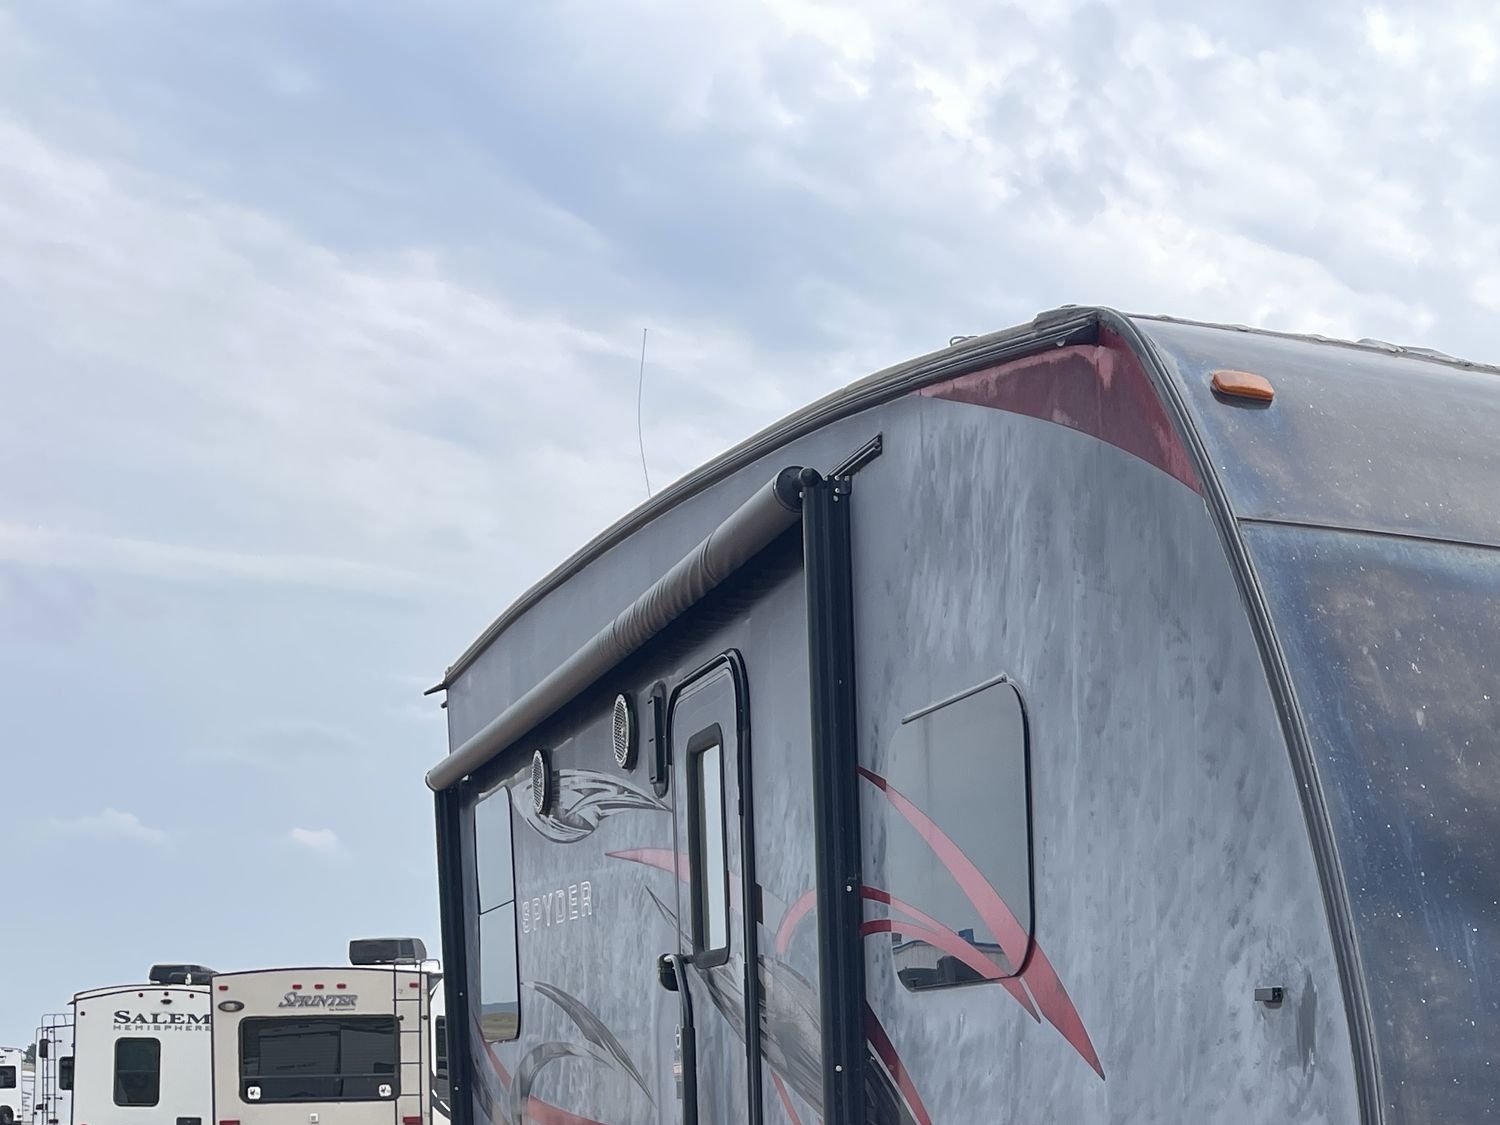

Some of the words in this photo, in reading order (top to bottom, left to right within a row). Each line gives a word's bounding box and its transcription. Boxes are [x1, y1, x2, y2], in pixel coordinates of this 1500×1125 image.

[522, 880, 592, 933] SPYDER
[278, 991, 358, 1008] SPRINTER
[113, 1010, 211, 1025] SALEM
[113, 1024, 211, 1032] HEMISPHERE
